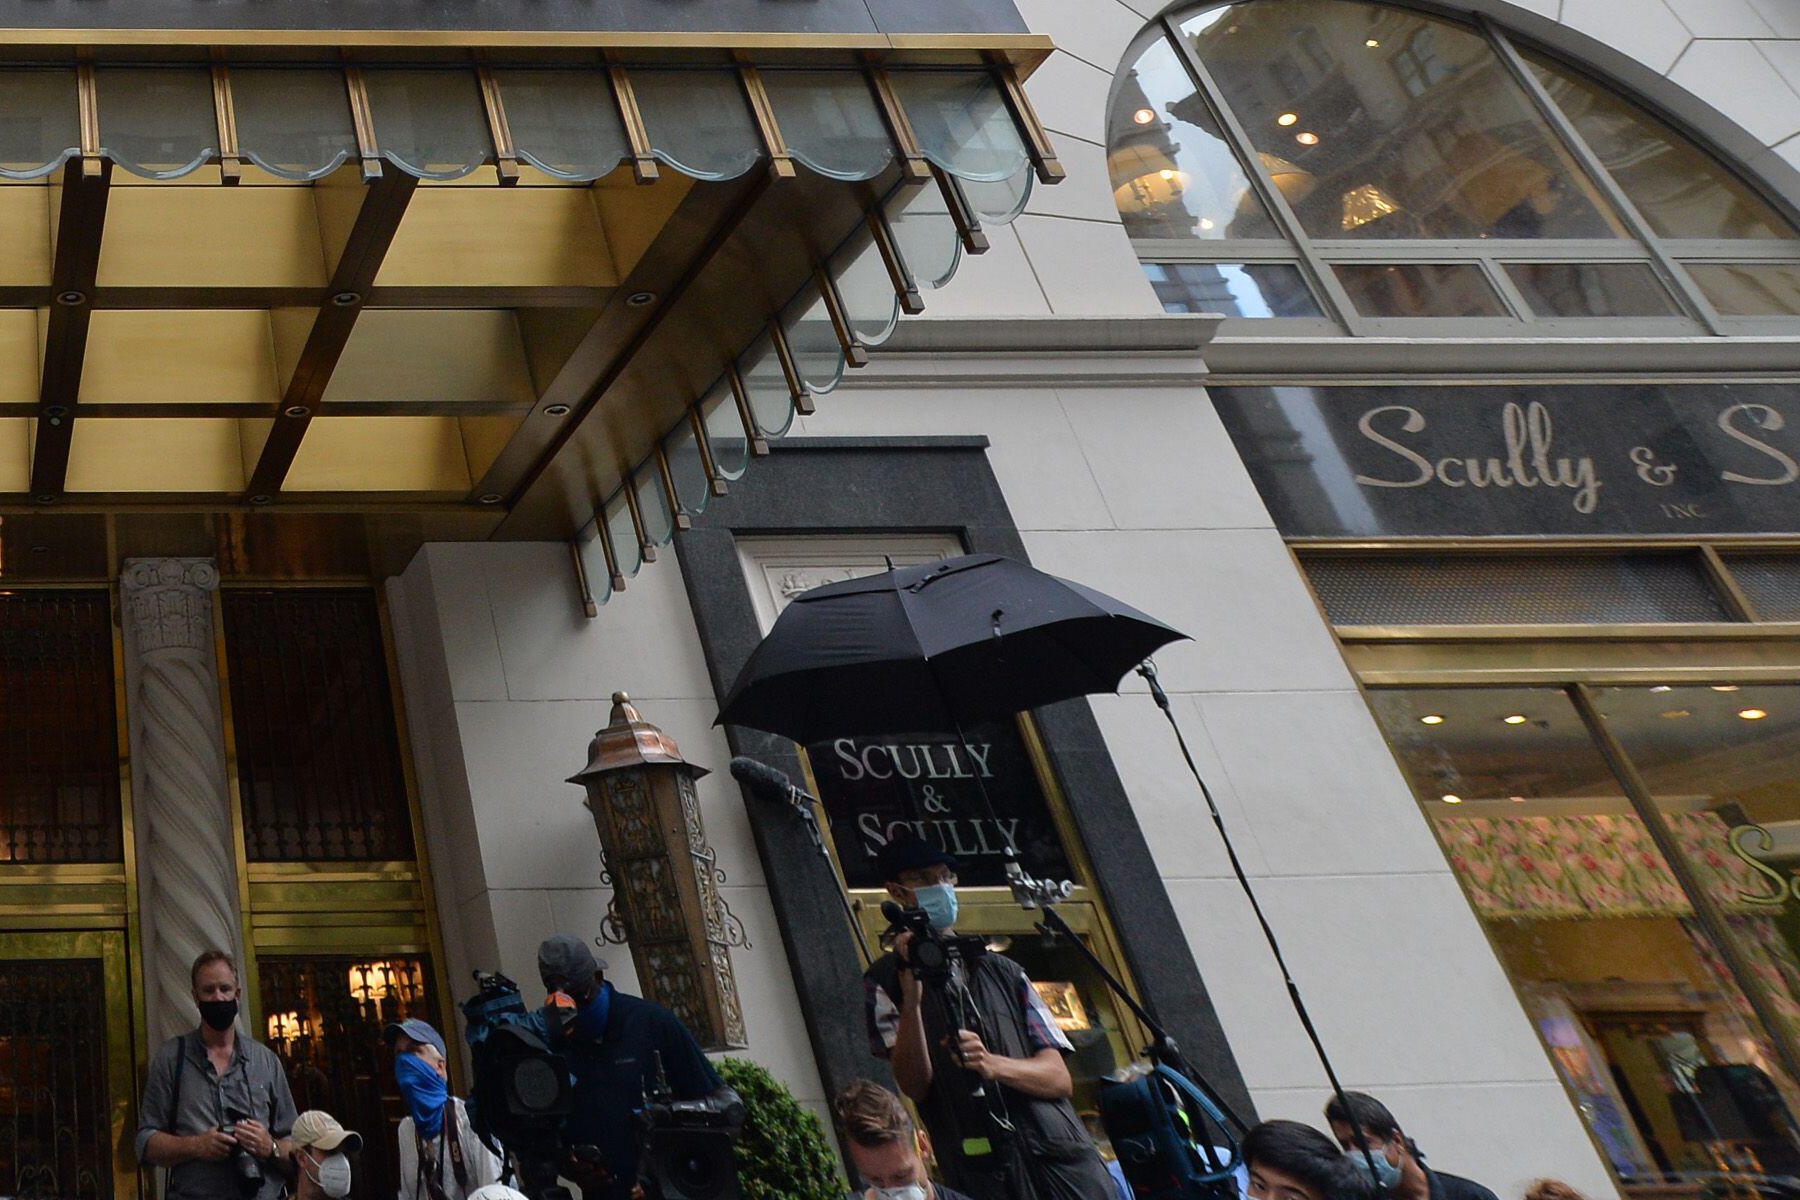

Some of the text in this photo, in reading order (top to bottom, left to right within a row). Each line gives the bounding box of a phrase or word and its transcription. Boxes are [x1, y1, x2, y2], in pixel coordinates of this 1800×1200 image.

[1355, 401, 1602, 514] Scully
[1630, 446, 1677, 487] &
[834, 738, 994, 781] SCULLY
[922, 784, 951, 813] &
